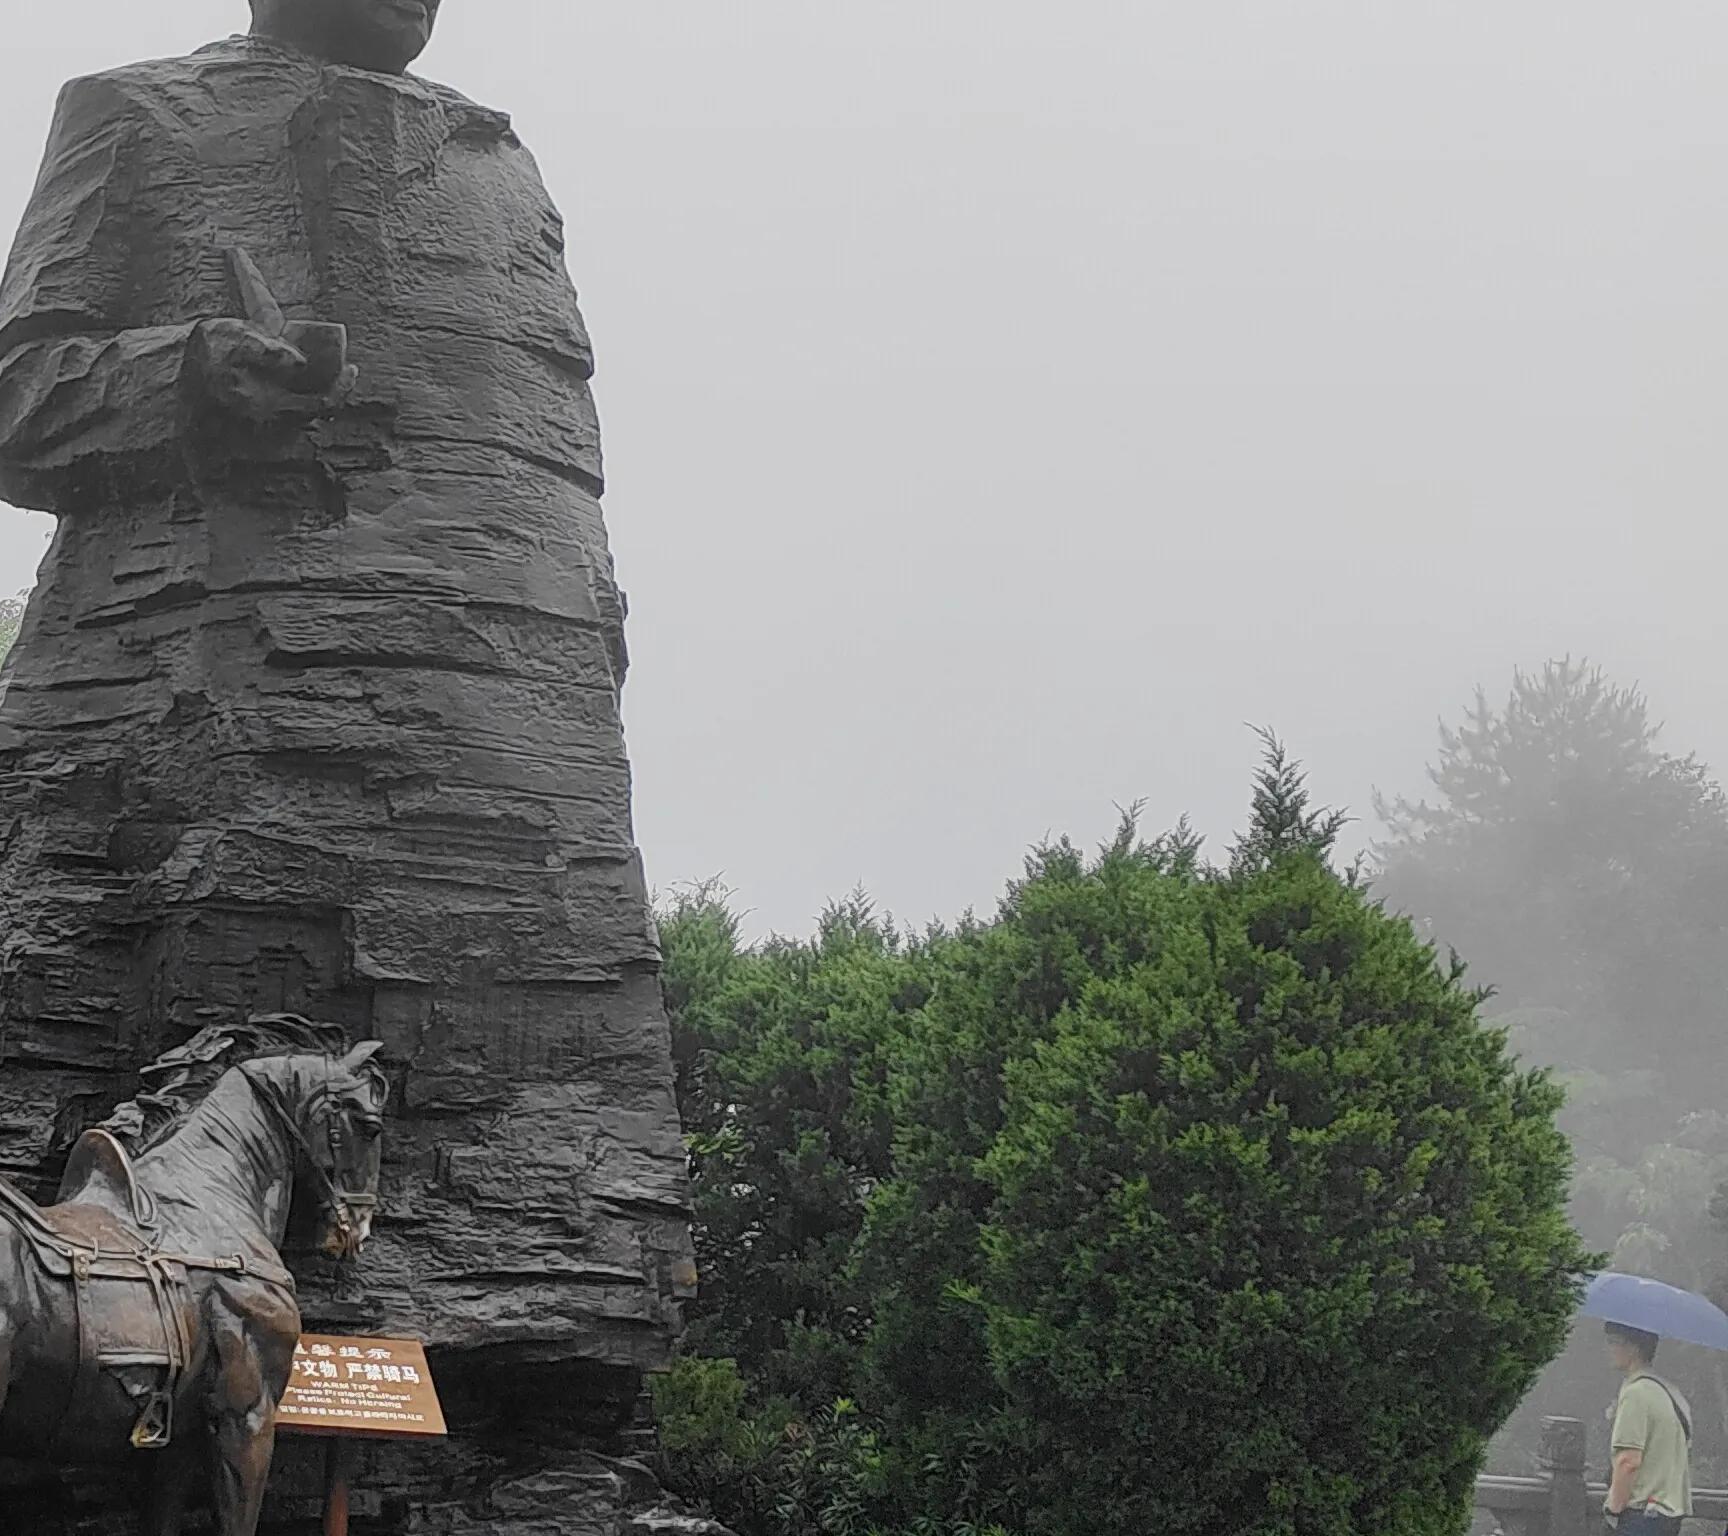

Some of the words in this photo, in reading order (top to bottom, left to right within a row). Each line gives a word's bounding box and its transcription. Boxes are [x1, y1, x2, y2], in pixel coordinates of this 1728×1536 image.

[346, 1362, 419, 1383] 严禁骑马
[310, 1381, 349, 1389] WARM
[352, 1383, 378, 1392] TIPS
[324, 1387, 365, 1399] Protect
[367, 1391, 411, 1401] Cultural
